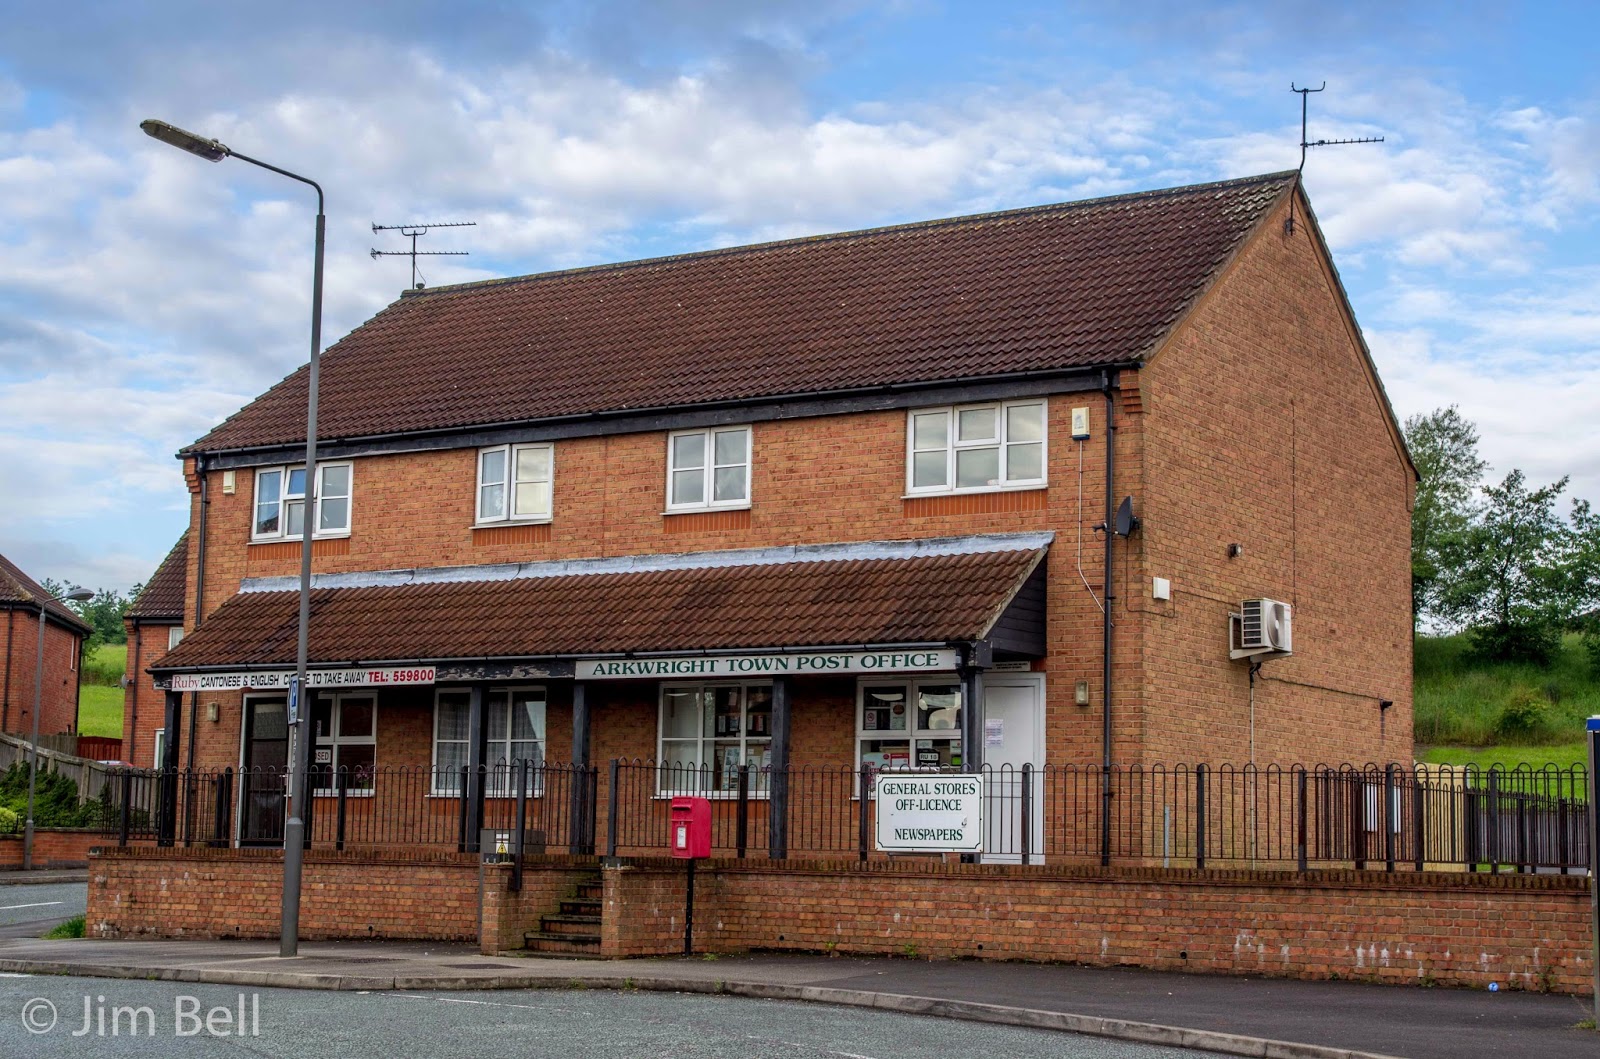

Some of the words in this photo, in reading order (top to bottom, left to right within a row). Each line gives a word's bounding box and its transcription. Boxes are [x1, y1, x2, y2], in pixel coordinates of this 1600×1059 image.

[592, 659, 719, 676] ARKWRIGHT
[726, 657, 789, 672] TOWN
[796, 655, 853, 670] POST
[860, 653, 939, 669] OFFICE
[173, 675, 200, 690] Ruby
[201, 676, 241, 688] CANTONESE
[243, 675, 249, 686] &
[250, 674, 279, 686] ENGLISH
[312, 673, 322, 685] TO
[324, 672, 342, 684] TAKE
[344, 671, 367, 683] AWAY
[368, 671, 389, 683] TEL:
[393, 669, 434, 682] 559800
[883, 782, 931, 795] GENERAL
[934, 782, 976, 795] STORES
[896, 799, 962, 811] OFF-LICENCE
[894, 828, 963, 841] NEWSPAPERS
